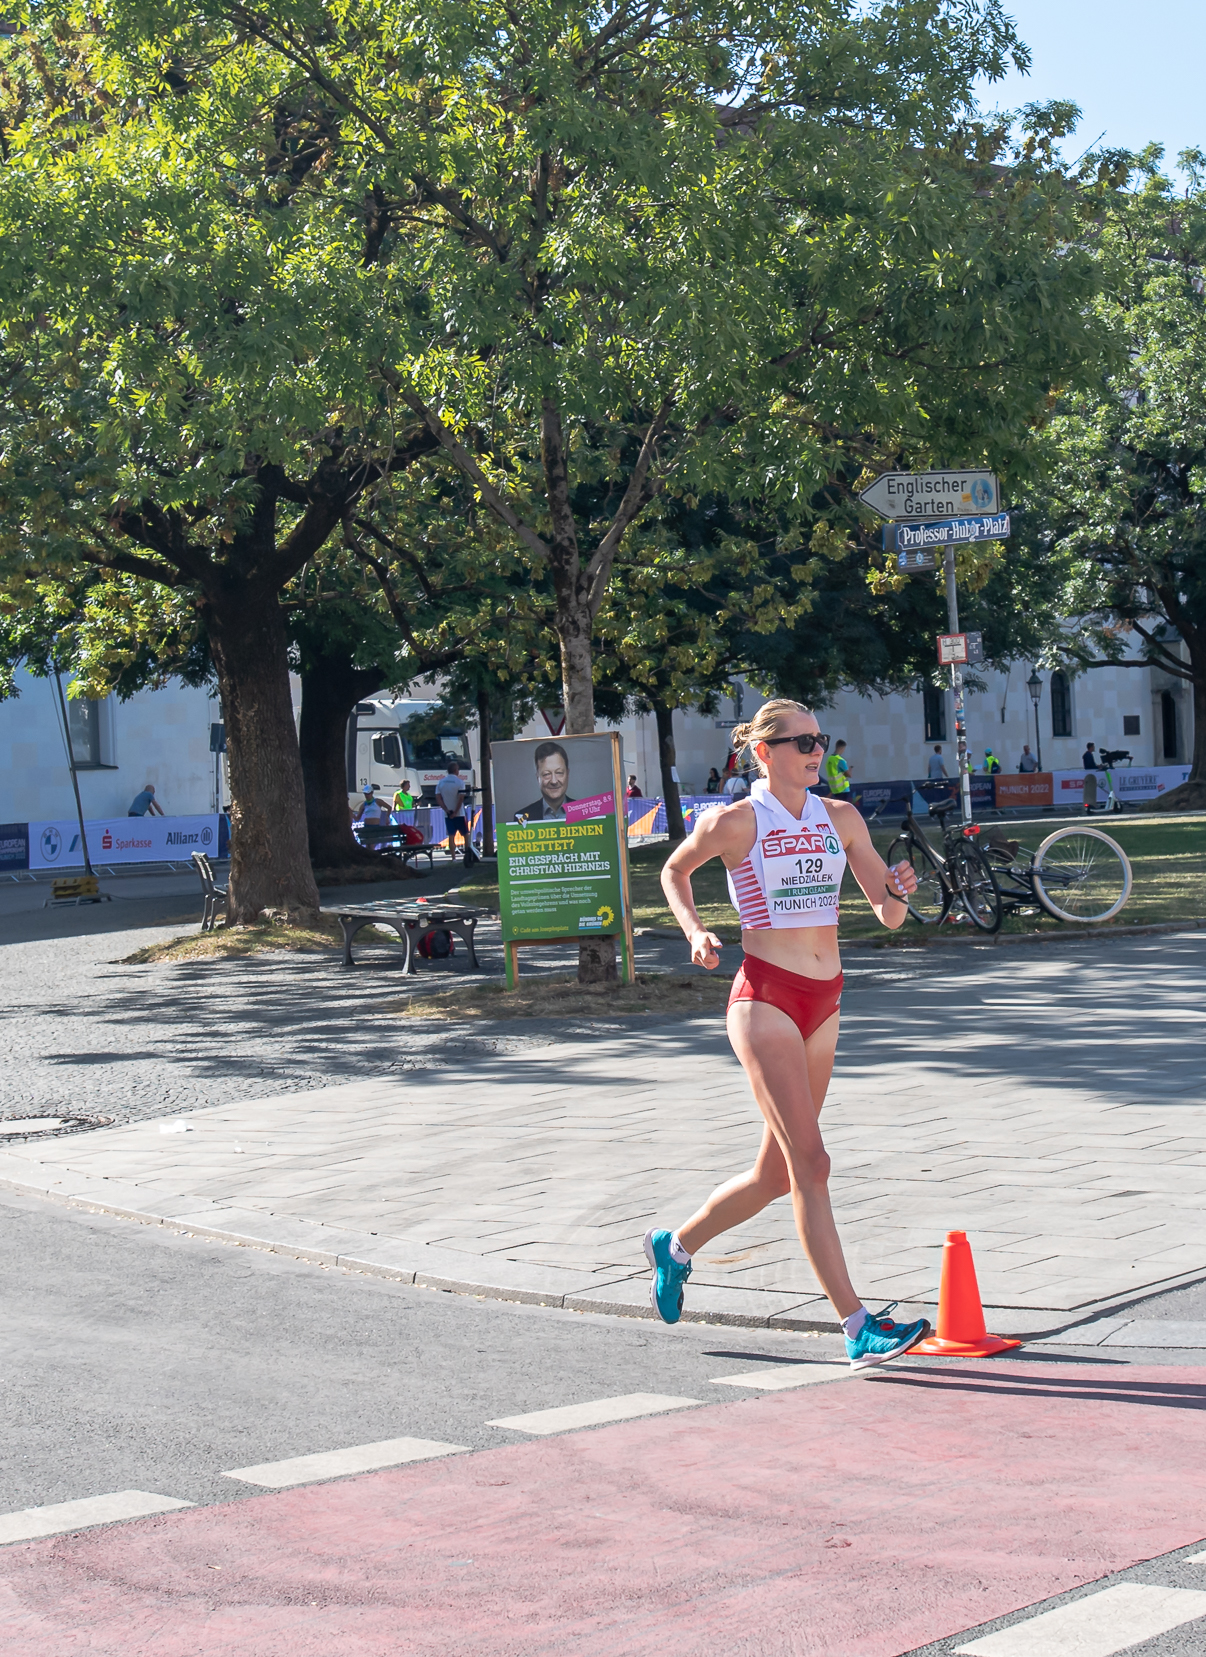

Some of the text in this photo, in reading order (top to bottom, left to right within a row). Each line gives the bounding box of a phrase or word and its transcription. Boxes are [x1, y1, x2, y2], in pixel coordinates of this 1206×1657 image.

[887, 477, 967, 498] Englischer
[904, 498, 954, 514] Garten
[903, 518, 1007, 545] Professor-Hubr-Platz
[360, 778, 368, 786] 13
[999, 783, 1049, 795] MUNICH 2022
[863, 788, 892, 798] EUROPEAN
[589, 806, 601, 814] Uhr
[166, 831, 199, 845] Allianz
[507, 825, 603, 841] SIND DIE BIENEN
[115, 838, 152, 851] Sparkasse
[508, 839, 575, 854] GERETTET?
[764, 836, 825, 856] SPAR
[509, 852, 600, 866] EIN GESPRÄCH MIT
[795, 858, 823, 874] 129
[509, 861, 610, 876] CHRISTIAN HIERNEIS
[781, 874, 833, 886] NIEDZIALEK
[793, 888, 808, 896] RUN
[774, 895, 837, 911] MUNICH 2022
